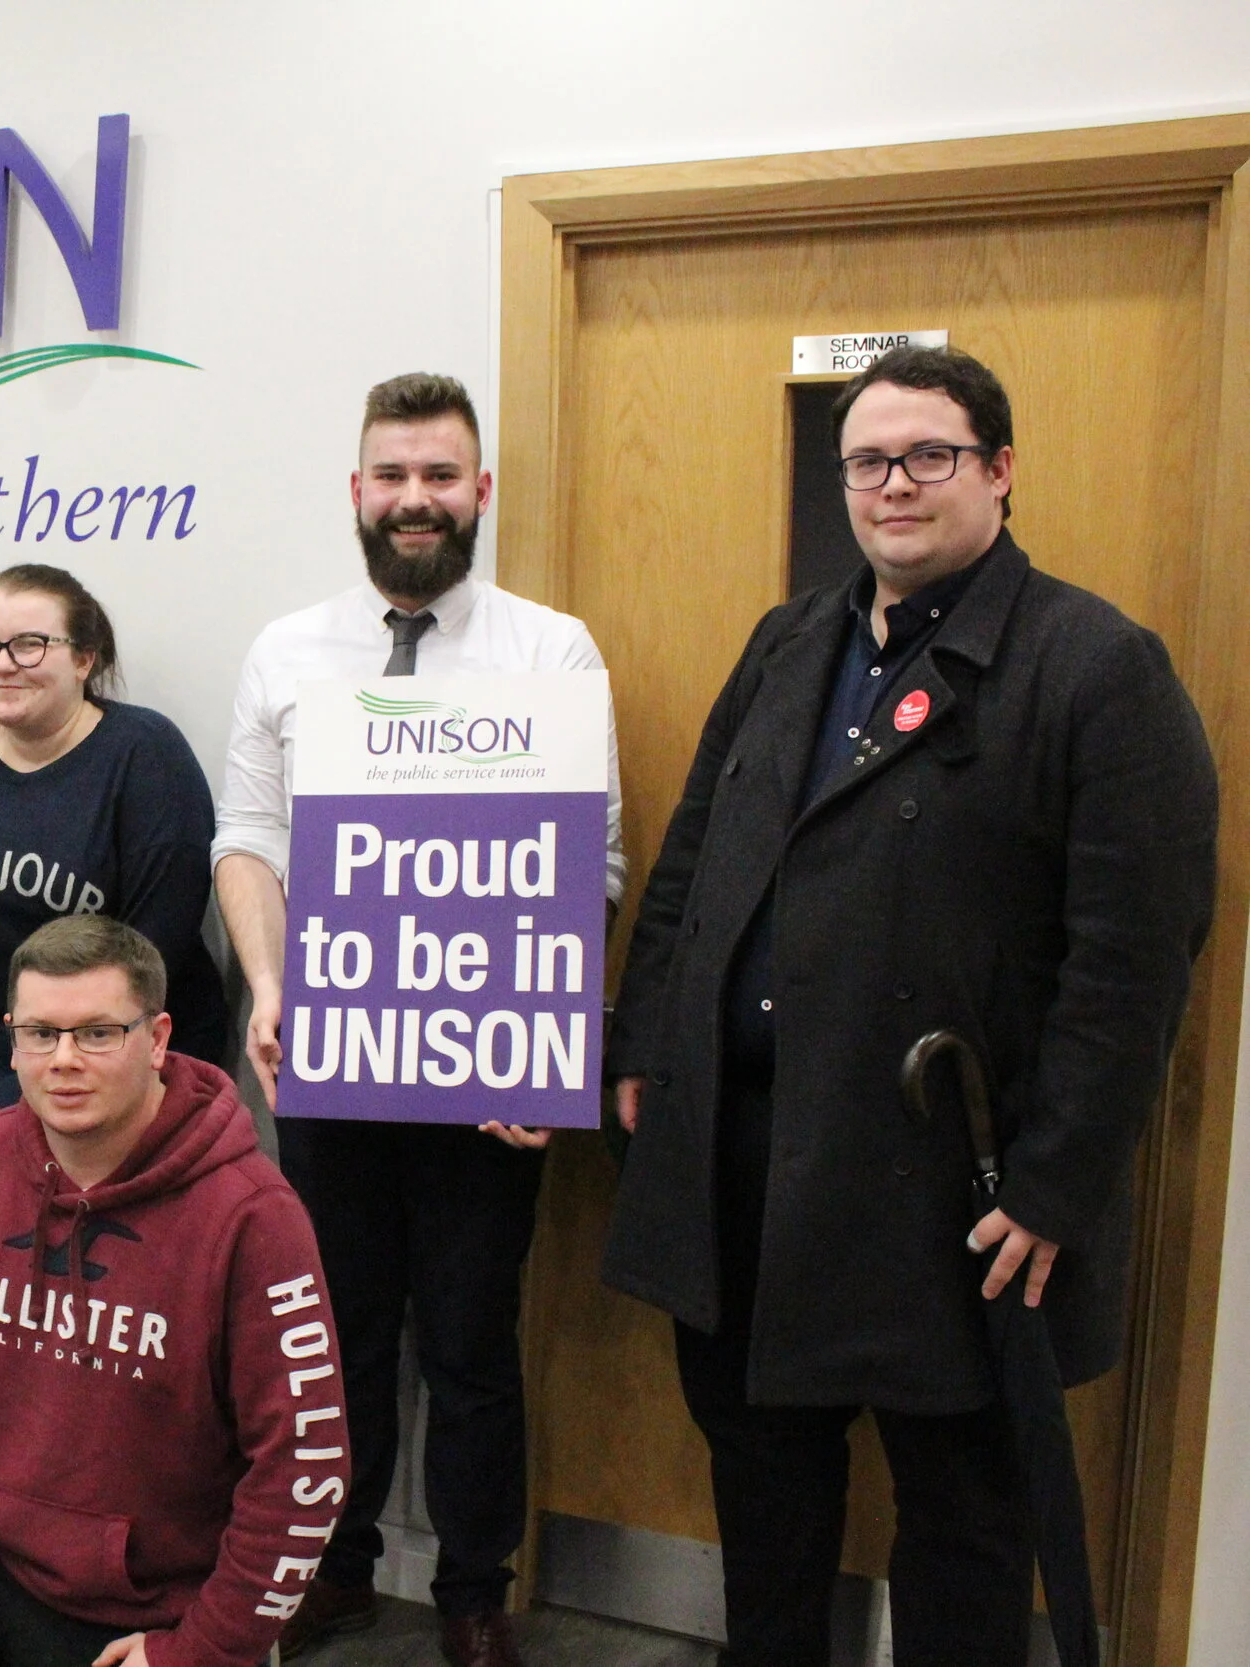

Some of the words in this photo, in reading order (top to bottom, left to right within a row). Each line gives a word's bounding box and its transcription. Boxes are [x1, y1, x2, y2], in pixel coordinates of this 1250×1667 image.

[830, 335, 909, 353] SEMINAR
[833, 354, 879, 370] ROO
[367, 717, 532, 755] UNISON
[366, 765, 389, 781] the
[393, 765, 438, 784] public
[443, 765, 496, 779] service
[499, 763, 546, 778] union
[334, 822, 556, 898] Proud
[300, 916, 373, 989] to
[397, 916, 489, 992] be
[515, 916, 583, 993] in
[292, 1006, 586, 1090] UNISON
[255, 1274, 344, 1621] HOLLISTER
